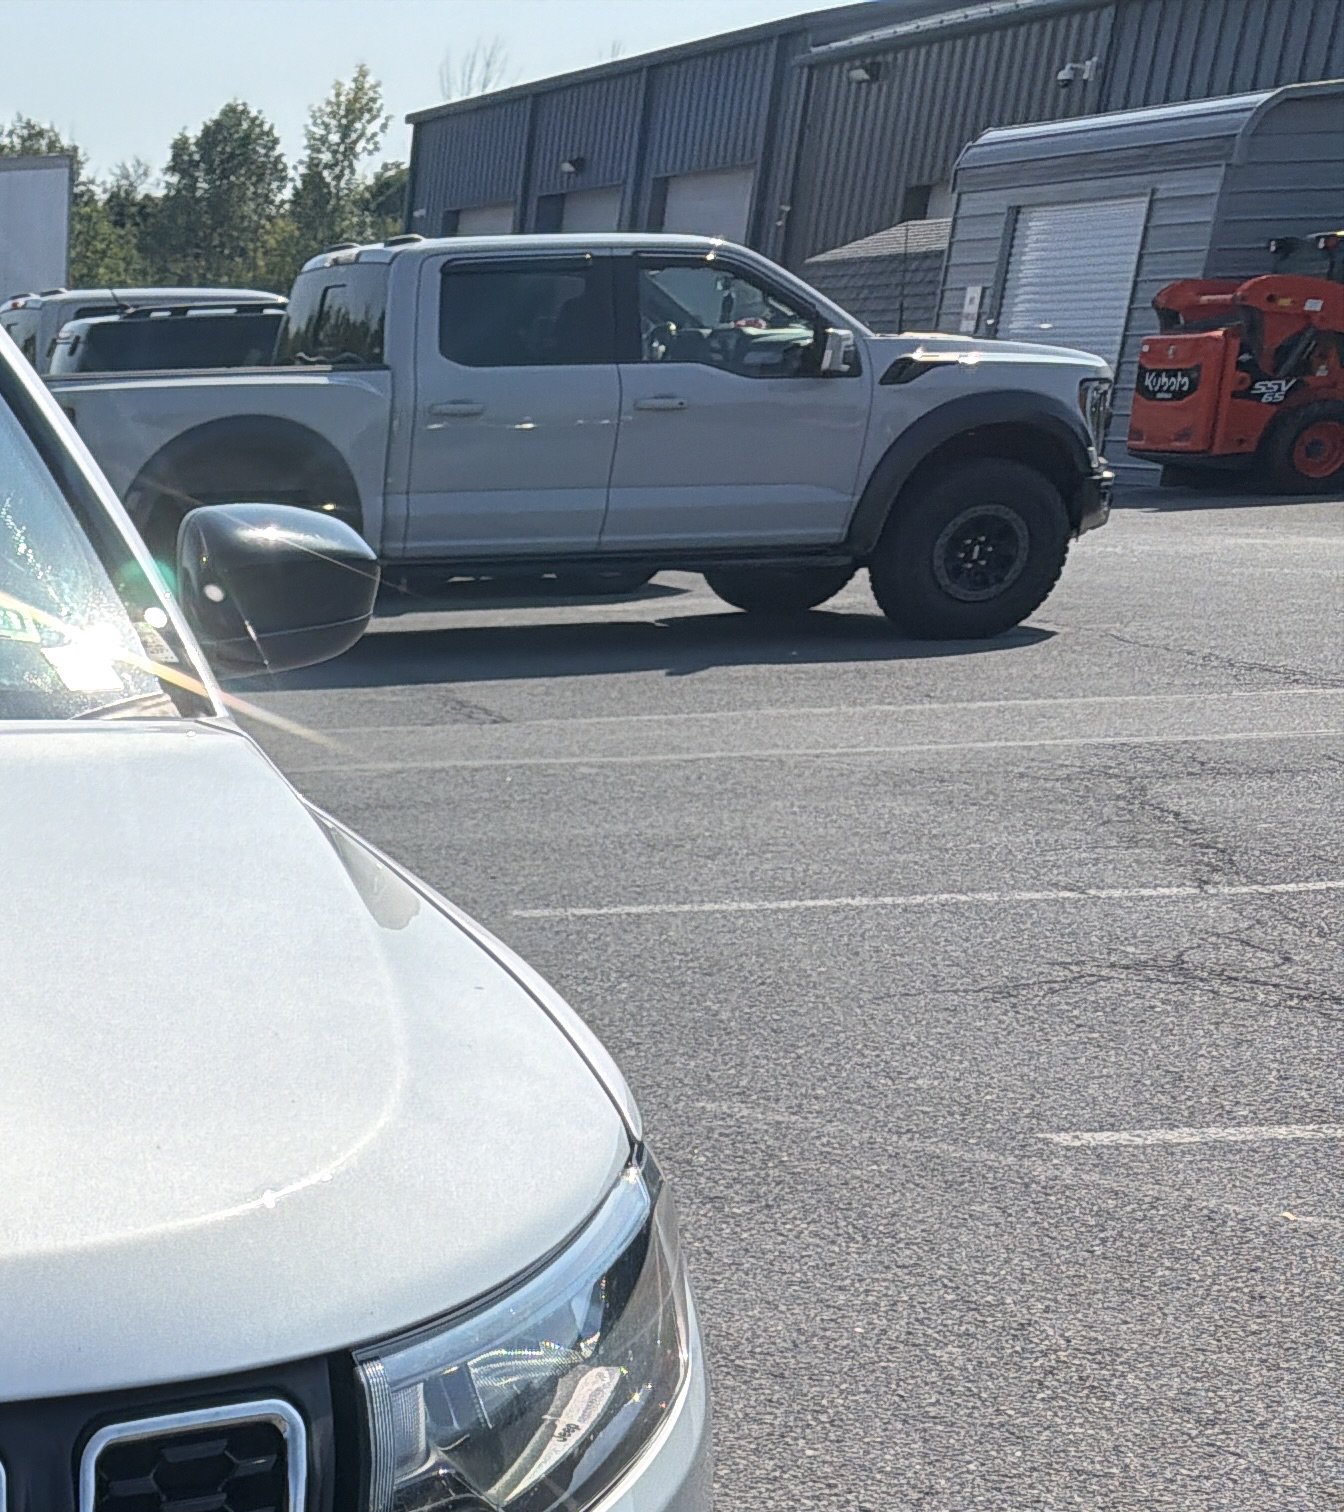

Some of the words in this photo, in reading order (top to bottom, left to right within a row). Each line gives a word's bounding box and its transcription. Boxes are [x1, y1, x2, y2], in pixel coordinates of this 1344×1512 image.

[1144, 371, 1189, 392] Kubota
[1250, 378, 1297, 394] SSV
[1261, 392, 1285, 403] 65
